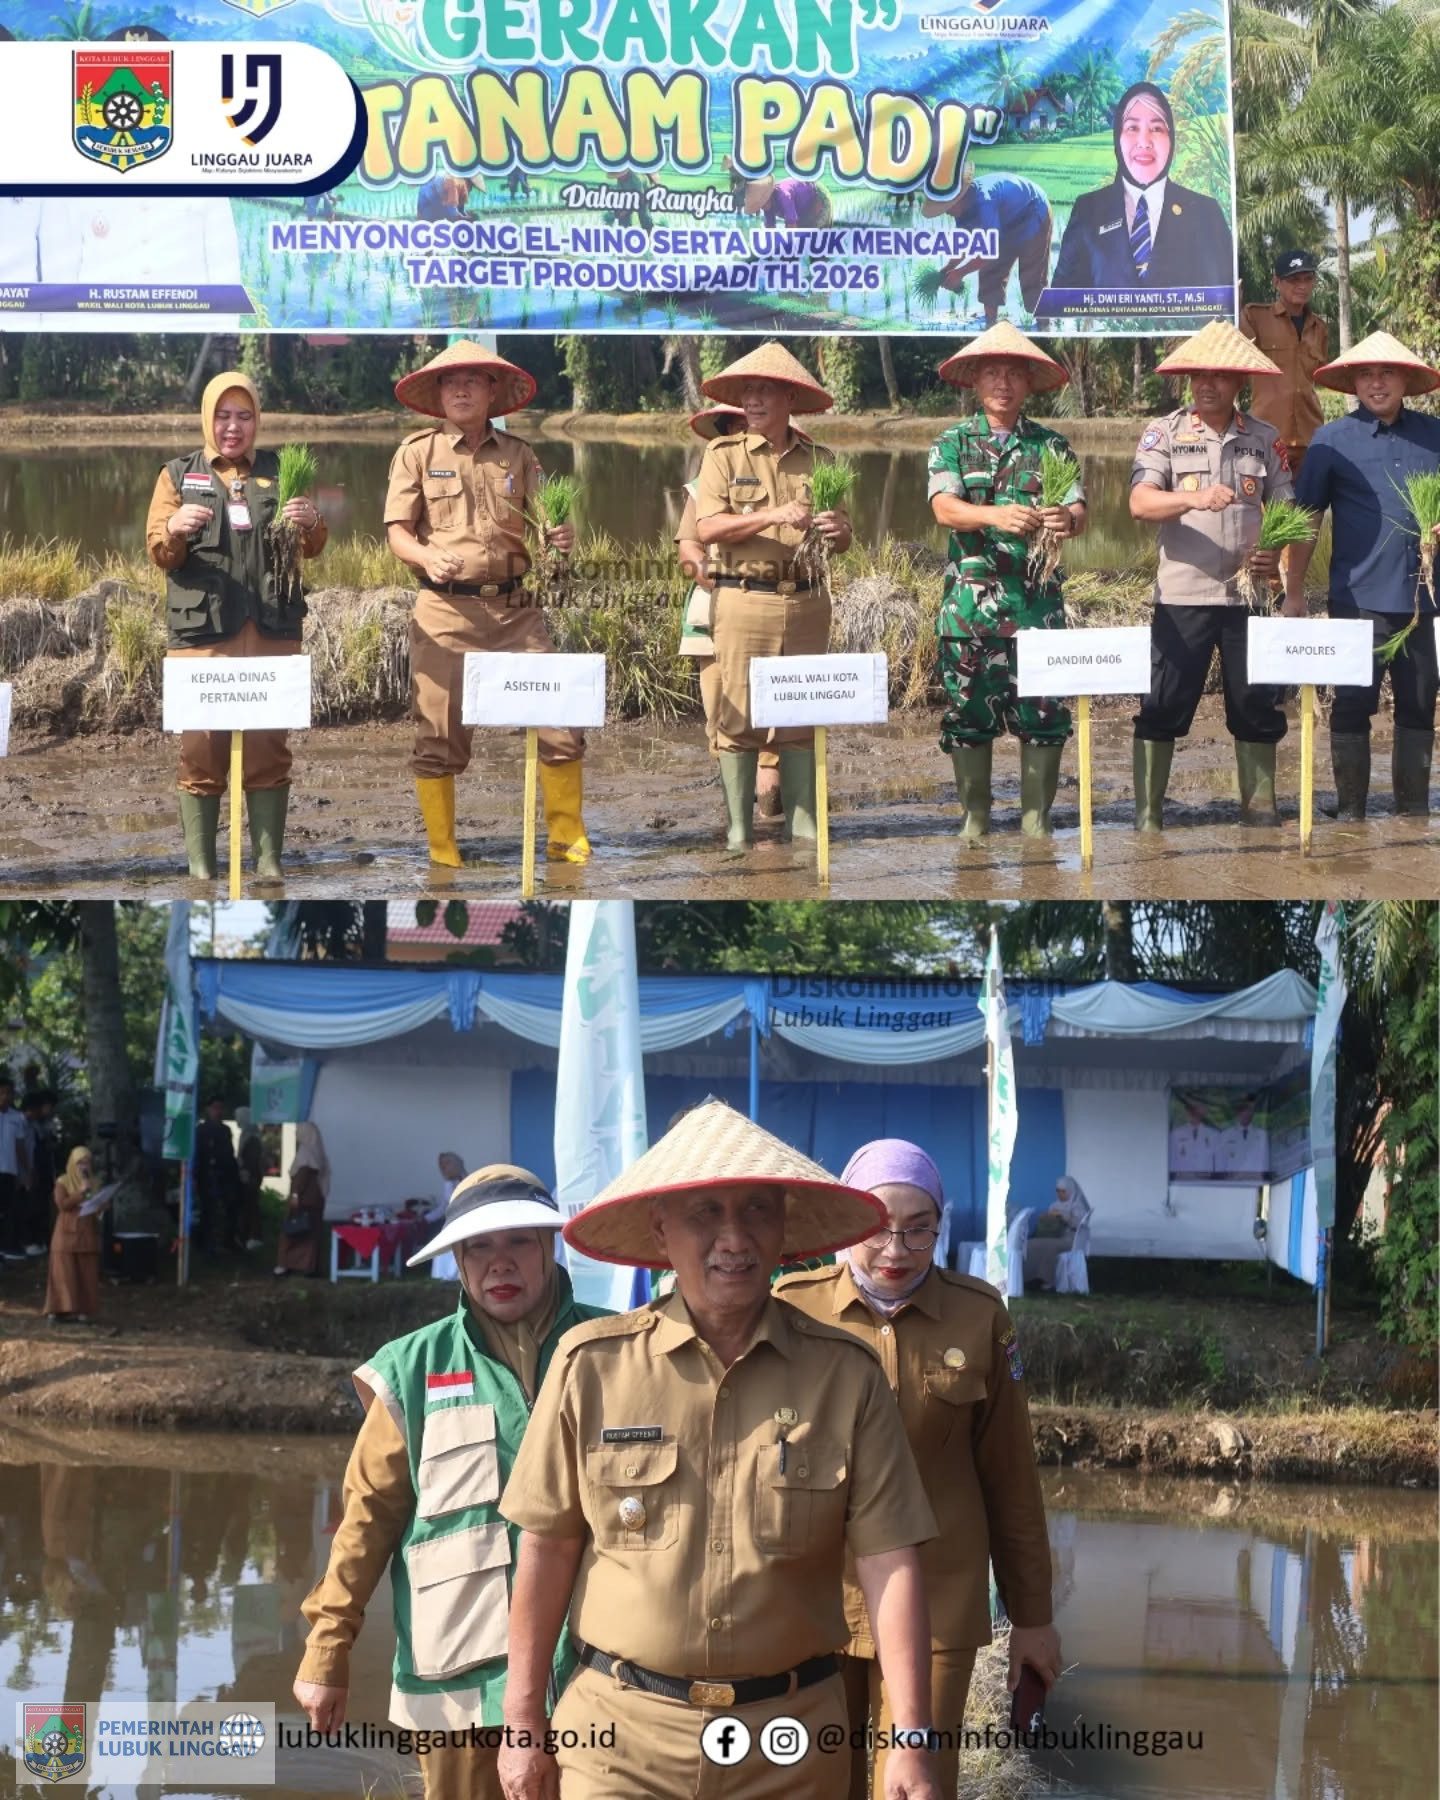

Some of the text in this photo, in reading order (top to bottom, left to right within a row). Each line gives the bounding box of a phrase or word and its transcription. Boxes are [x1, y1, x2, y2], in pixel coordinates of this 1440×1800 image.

[920, 18, 1049, 32] LINGGAU JUARA
[359, 66, 709, 187] TANAM
[562, 183, 734, 219] Dalam Rangka
[271, 223, 997, 256] MENYONGSONG EL-NINO SERTA UNTUK MENCAPAI
[408, 259, 880, 289] TARGET PRODUKSI PADI TH. 2026
[89, 289, 198, 300] H. RUSTAM EFFENDI
[1083, 293, 1097, 306] Hj.
[1098, 293, 1117, 304] DWI
[1119, 293, 1134, 304] ERI
[103, 301, 124, 309] WALI
[124, 301, 146, 309] KOTA
[175, 301, 210, 309] LINGGAU
[1285, 645, 1336, 656] KAPOLRES
[1047, 653, 1122, 667] DANDIM 0406
[191, 671, 277, 684] KEPALA DINAS
[770, 672, 858, 684] WAKIL WALI KOTA
[503, 681, 550, 692] ASISTEN
[200, 691, 268, 704] PERTANIAN
[774, 689, 856, 701] LUBUK LINGGAU
